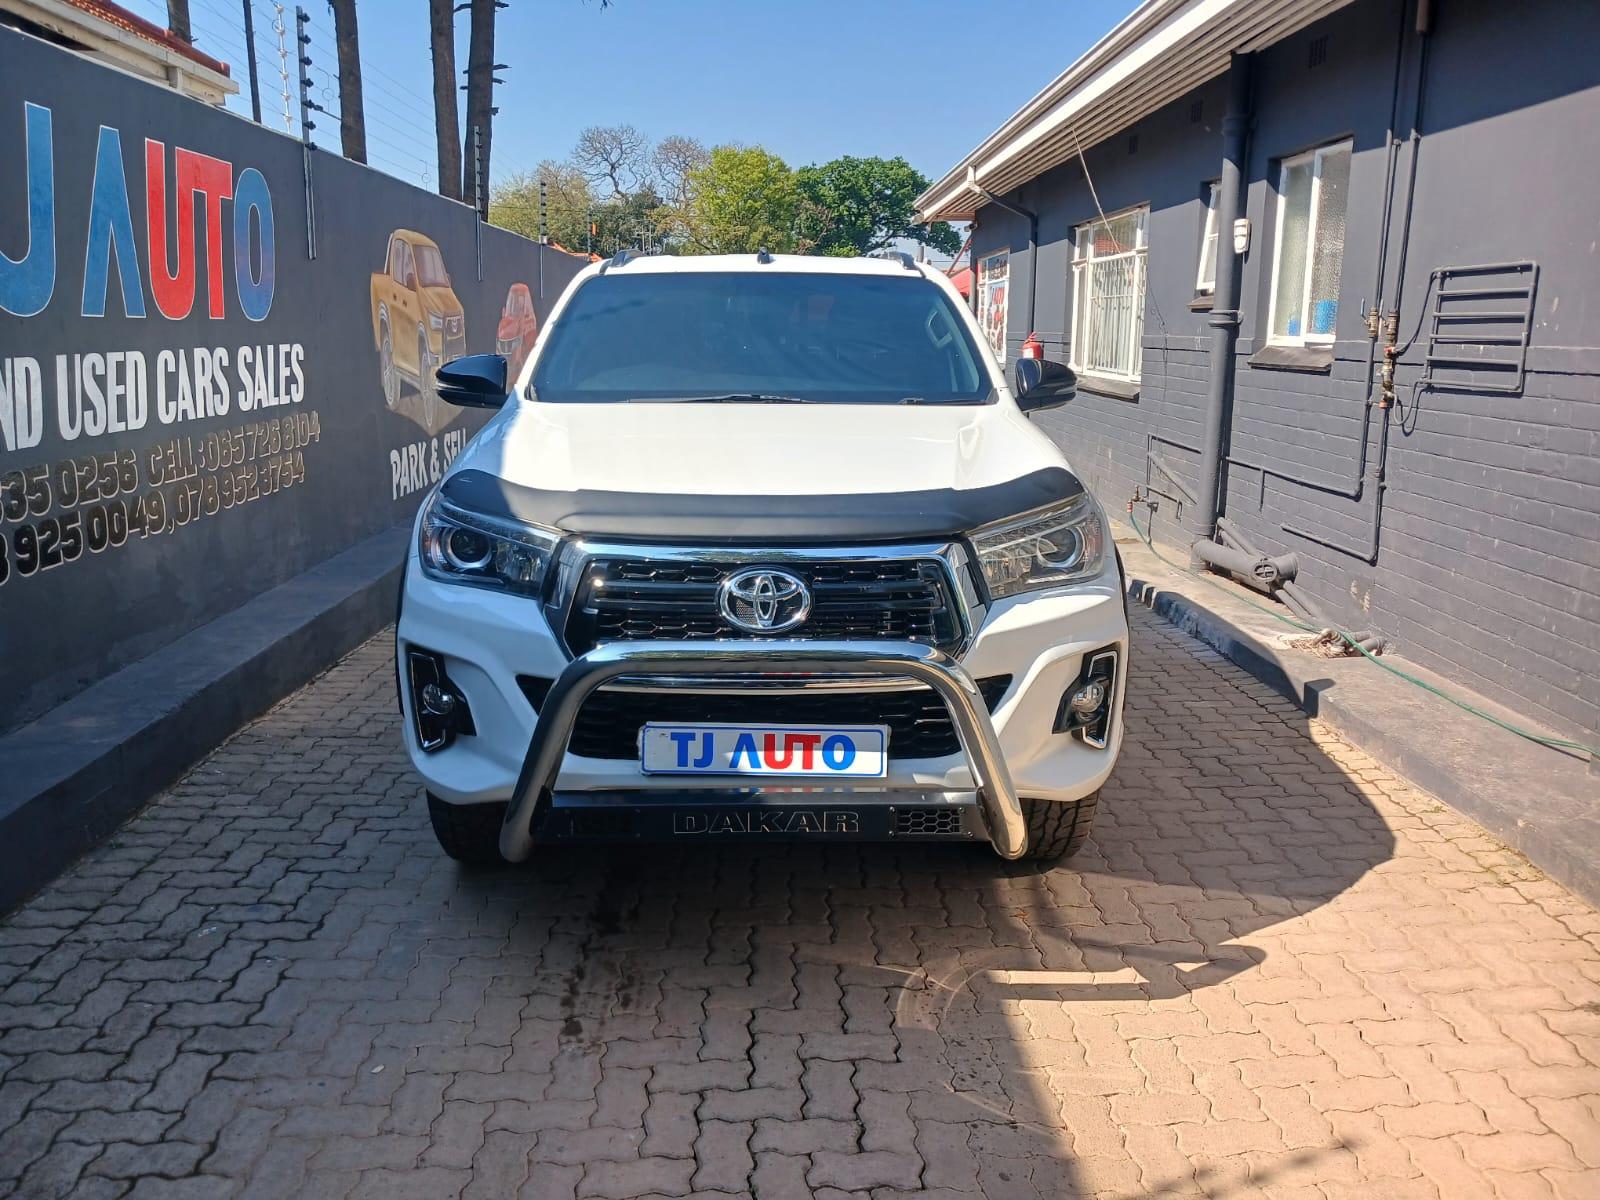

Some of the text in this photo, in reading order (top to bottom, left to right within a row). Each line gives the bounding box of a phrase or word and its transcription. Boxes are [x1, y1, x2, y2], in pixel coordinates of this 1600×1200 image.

[81, 124, 275, 322] AUTO
[56, 350, 148, 441] USED
[156, 347, 230, 425] CARS
[237, 343, 305, 412] SALES
[0, 463, 52, 525] 35
[390, 441, 428, 500] PARK
[430, 437, 441, 484] &
[670, 732, 856, 771] TJ AUTO
[673, 810, 860, 834] DAKAR
